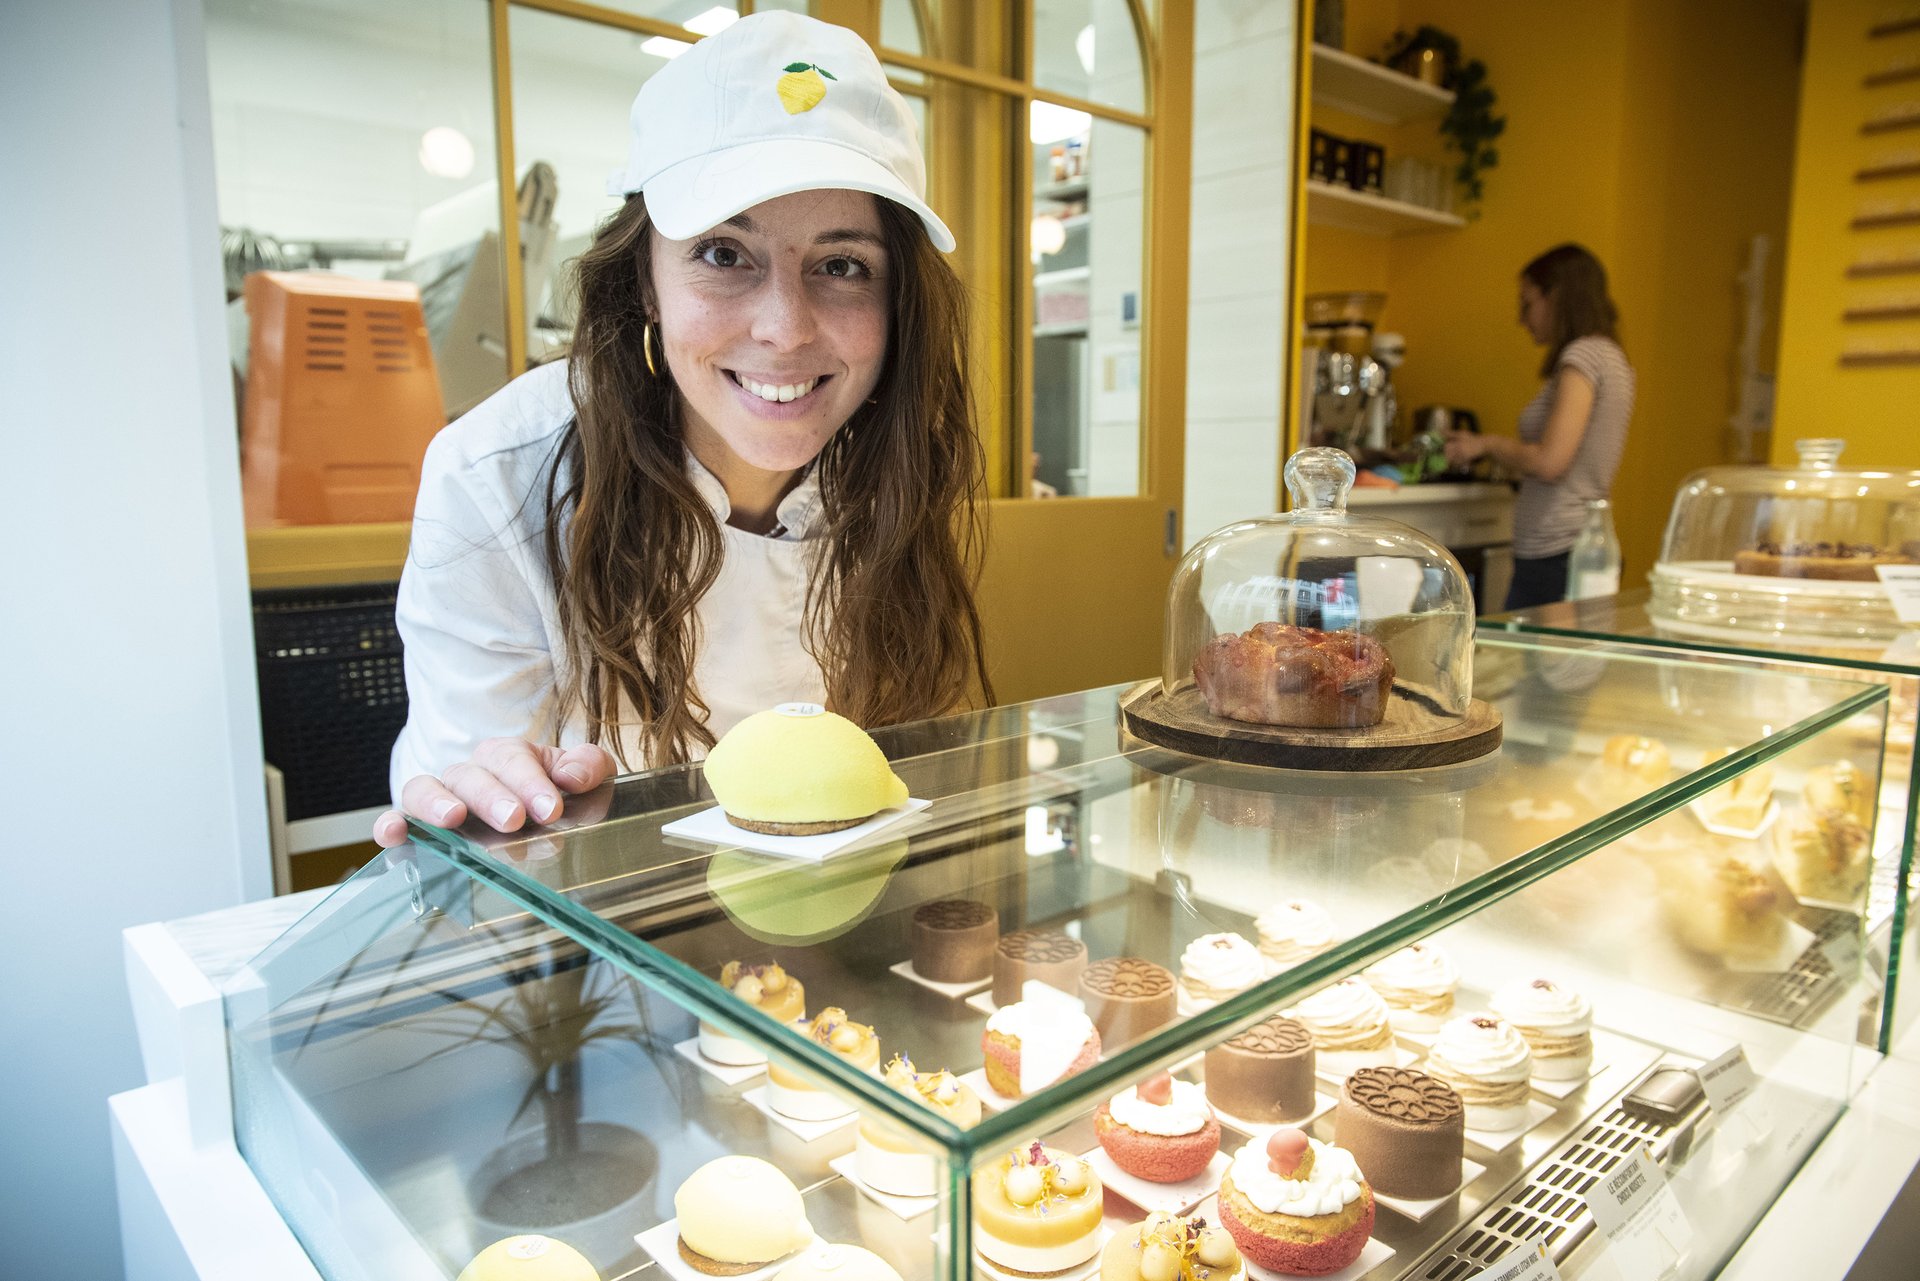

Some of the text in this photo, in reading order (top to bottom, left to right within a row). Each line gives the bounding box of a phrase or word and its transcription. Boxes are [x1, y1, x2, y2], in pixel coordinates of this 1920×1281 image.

[1607, 1182, 1616, 1195] LE
[1616, 1187, 1632, 1205] CHOCO
[1628, 1172, 1647, 1194] NOISETTE
